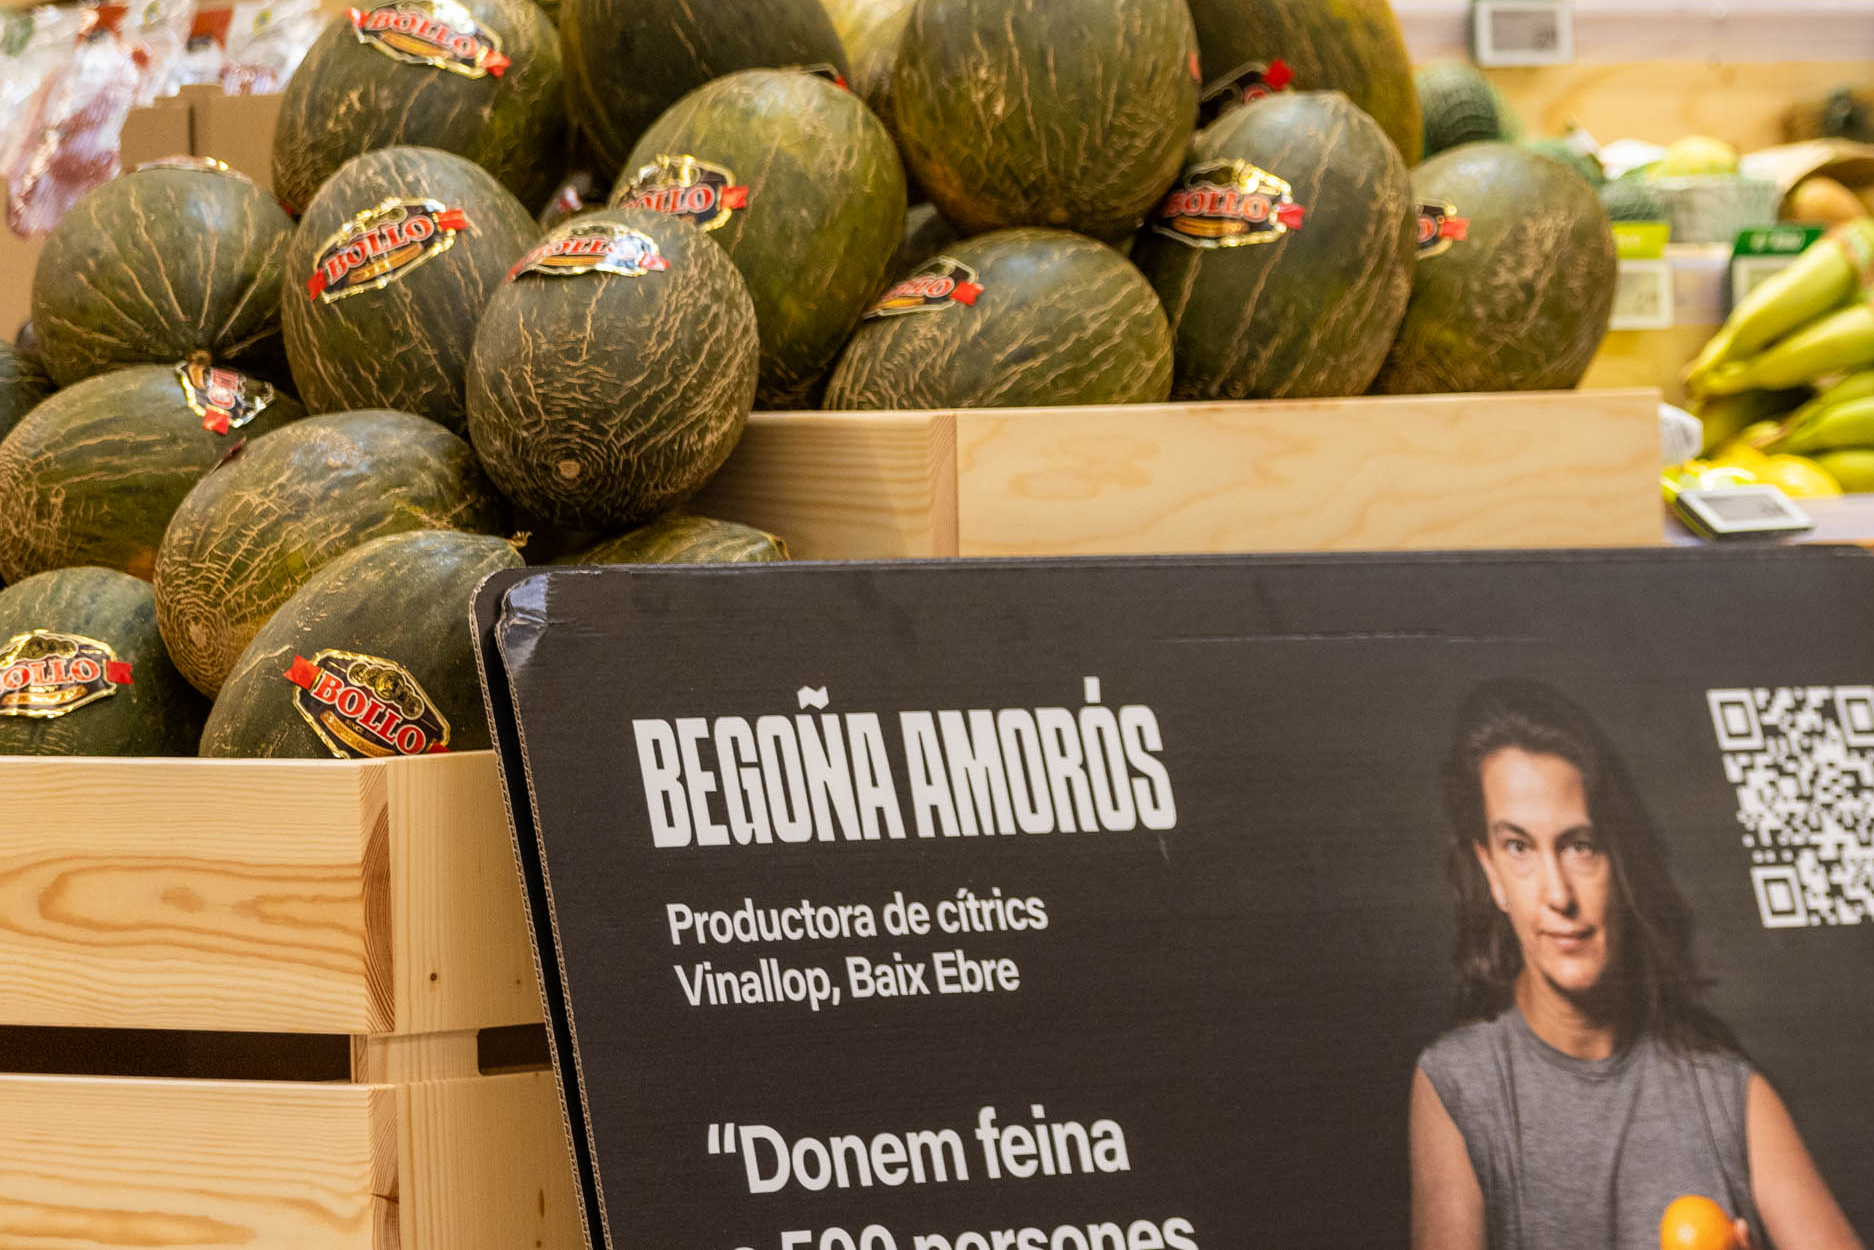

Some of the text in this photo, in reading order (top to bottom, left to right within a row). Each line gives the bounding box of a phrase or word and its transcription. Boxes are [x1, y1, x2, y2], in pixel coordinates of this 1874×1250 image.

[367, 7, 481, 58] BOLLO
[620, 183, 716, 214] OLLO
[325, 214, 435, 286] BOLLO
[0, 657, 101, 695] OLLO
[311, 670, 427, 755] BOLLO
[631, 676, 1178, 848] BEGOÑA AMORÓS
[666, 887, 1049, 945] Productora de cítrics
[673, 949, 1020, 1012] Vinallop, Baix Ebre
[975, 1104, 1131, 1179] feina
